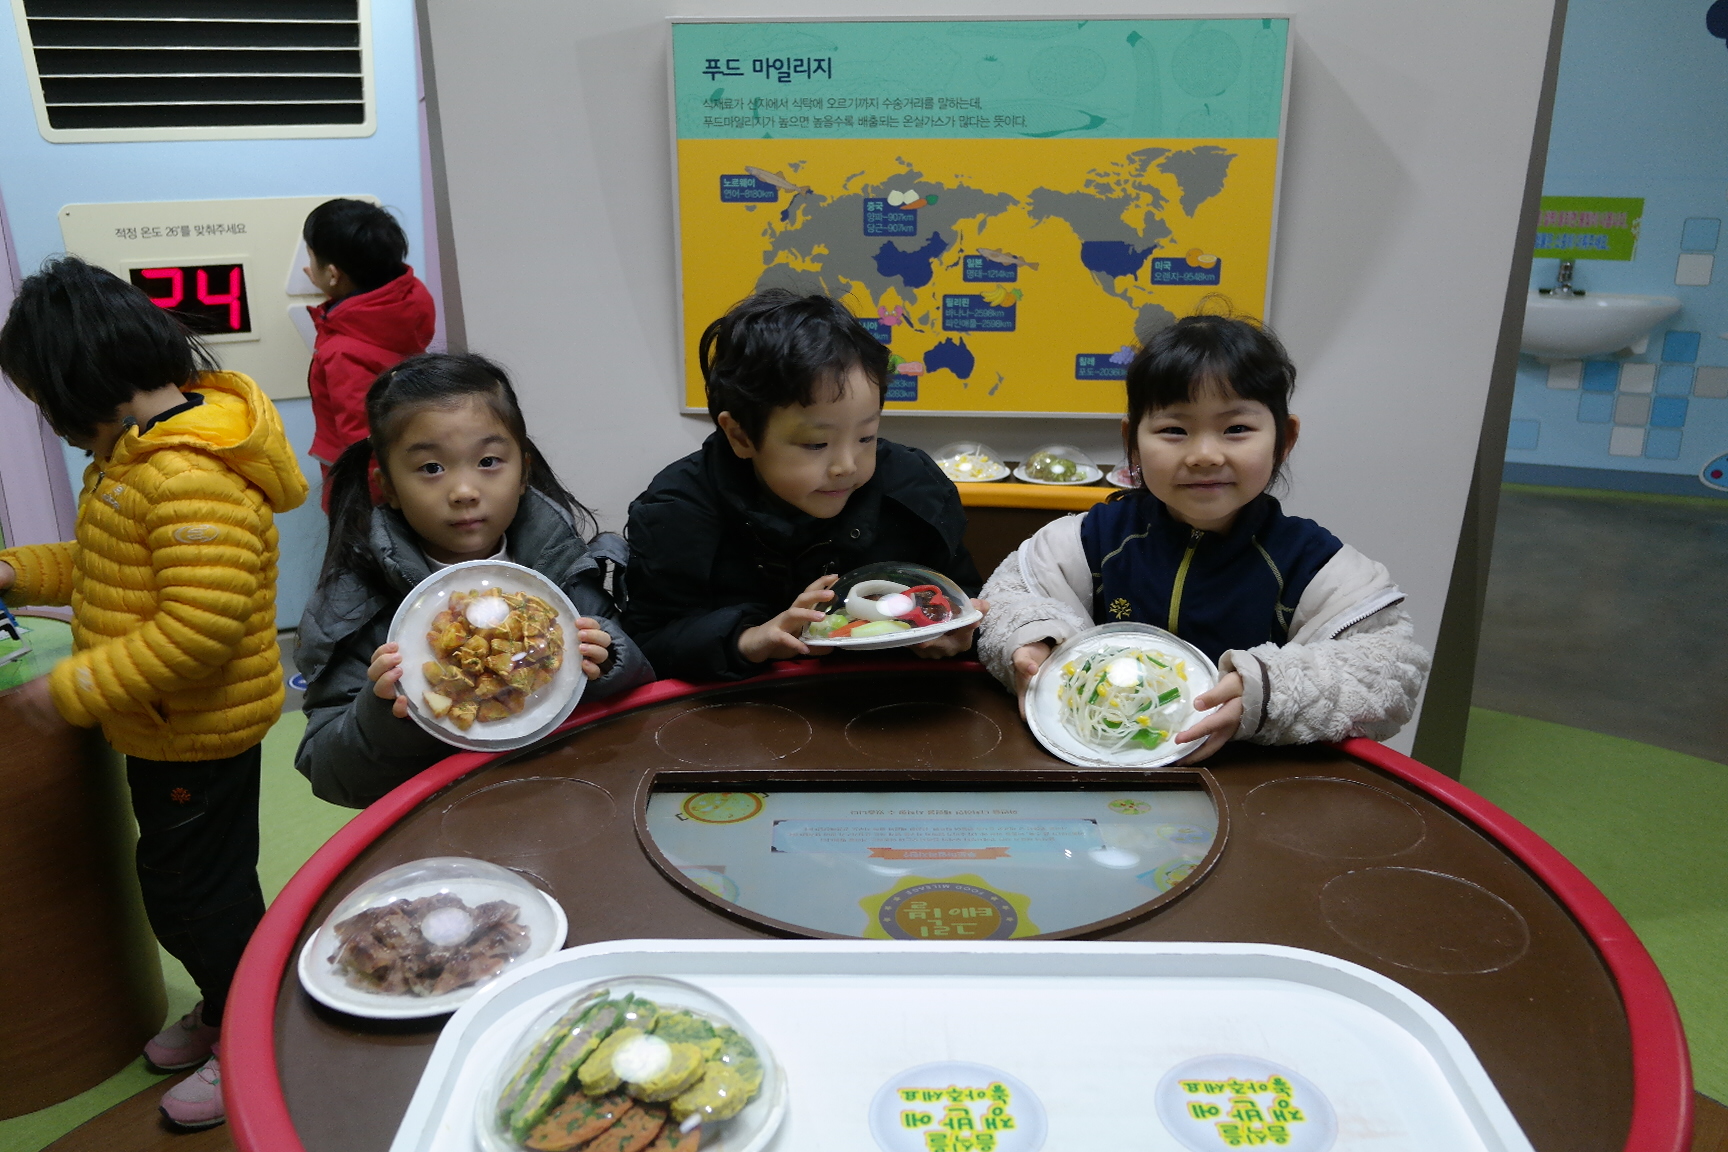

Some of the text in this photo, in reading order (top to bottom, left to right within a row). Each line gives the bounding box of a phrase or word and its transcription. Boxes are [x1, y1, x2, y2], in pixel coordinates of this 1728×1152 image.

[702, 57, 832, 83] 푸드 마일리지
[792, 97, 823, 110] 식탁에
[827, 97, 878, 109] 오르기까지
[882, 97, 934, 110] 수송거리를
[703, 115, 775, 128] 푸드마일리지가
[779, 115, 809, 128] 높으면
[813, 115, 854, 128] 높을수록
[858, 115, 899, 128] 배출되는
[903, 115, 955, 128] 온실가스가
[959, 115, 990, 128] 많다는
[723, 178, 755, 188] 노르웨이
[866, 201, 884, 212] 중국
[115, 227, 137, 240] 적정
[140, 226, 162, 239] 온도
[194, 223, 247, 237] 맞춰주세요
[966, 258, 983, 268] 일본
[1154, 260, 1172, 271] 미국
[945, 297, 970, 308] 필리핀
[1079, 356, 1096, 366] 칠레
[904, 883, 984, 896] FOOD MILEAGE
[903, 901, 993, 919] 테이블
[920, 919, 977, 937] 그린
[1183, 1077, 1292, 1098] 놓아주세요
[902, 1084, 1009, 1105] 놓아주세요
[1218, 1124, 1290, 1147] 음식을
[927, 1133, 995, 1152] 음식을
